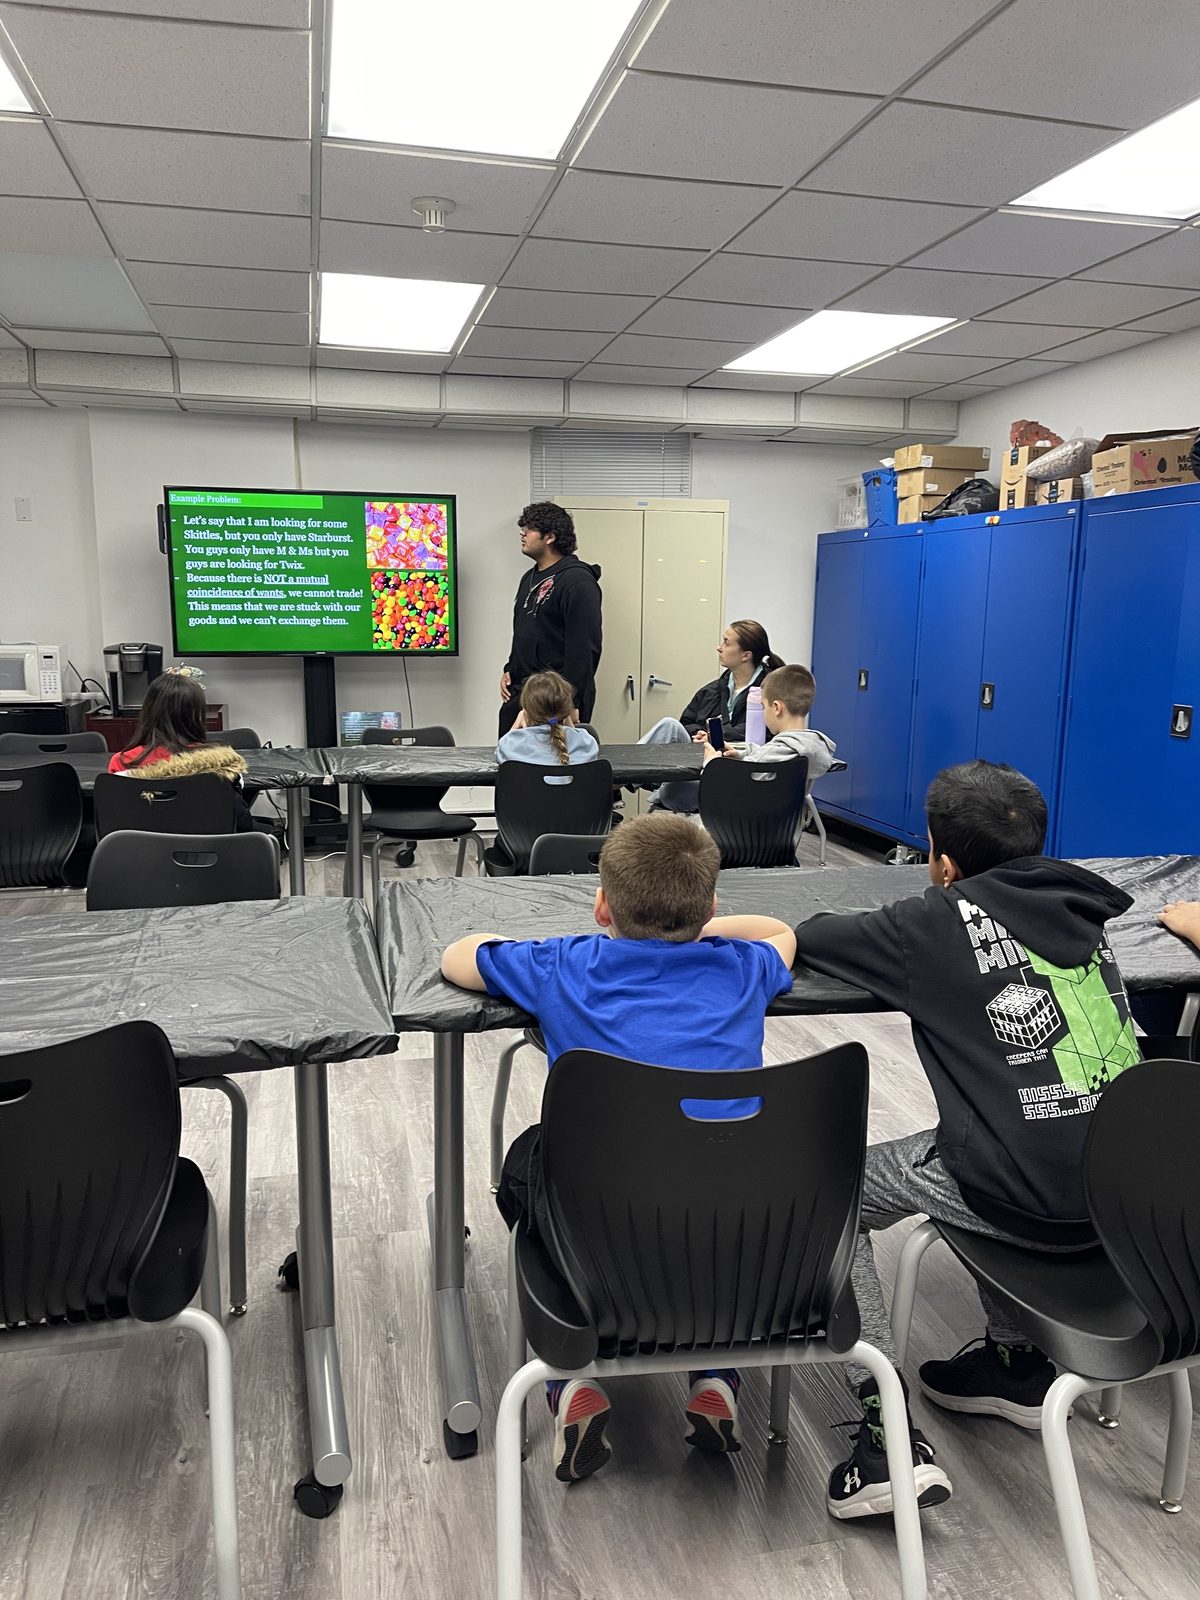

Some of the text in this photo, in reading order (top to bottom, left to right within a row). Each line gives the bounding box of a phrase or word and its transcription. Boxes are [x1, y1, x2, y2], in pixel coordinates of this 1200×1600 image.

[170, 494, 242, 504] Example Problem:
[208, 518, 224, 528] say
[226, 516, 246, 526] that
[247, 517, 252, 526] I
[271, 517, 306, 529] looking
[308, 518, 322, 528] for
[184, 530, 354, 542] Skittles, but you only have Starburst.
[184, 544, 349, 558] You guys only have M & Ms but you
[186, 558, 305, 571] guys are looking for Twix.
[186, 573, 226, 582] Because
[227, 574, 252, 583] there
[254, 574, 262, 583] is
[263, 574, 287, 584] NOT
[296, 574, 329, 584] mutual
[187, 588, 243, 598] coincidence
[244, 588, 255, 598] of
[256, 589, 287, 598] wants,
[303, 590, 335, 598] cannot
[336, 589, 363, 598] trade!
[187, 601, 209, 610] This
[244, 602, 263, 611] that
[296, 602, 321, 611] stuck
[322, 602, 343, 612] with
[189, 615, 217, 626] goods
[219, 616, 237, 624] and
[278, 616, 321, 626] exchange
[322, 616, 349, 625] them.
[1030, 1007, 1051, 1030] TNT
[996, 1020, 1023, 1034] TNT
[1006, 1051, 1036, 1060] CREEPERS
[1008, 1058, 1033, 1066] TRIGGER
